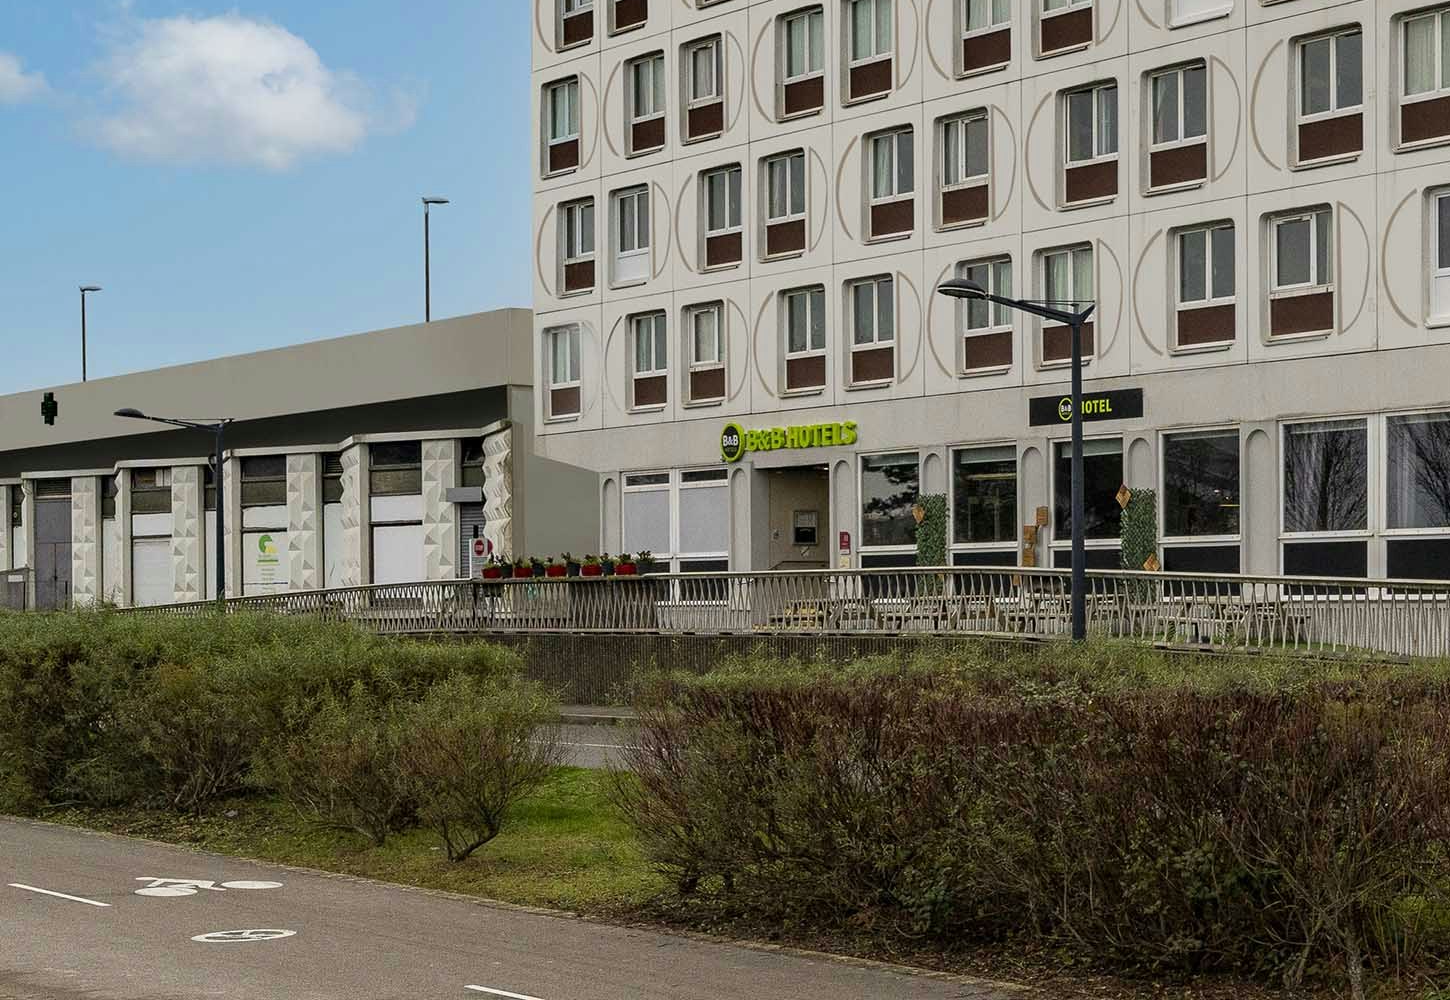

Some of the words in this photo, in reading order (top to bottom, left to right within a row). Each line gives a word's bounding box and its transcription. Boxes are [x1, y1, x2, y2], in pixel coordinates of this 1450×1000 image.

[722, 435, 739, 447] B&B
[745, 429, 785, 451] B&B
[785, 420, 857, 449] HOTELS
